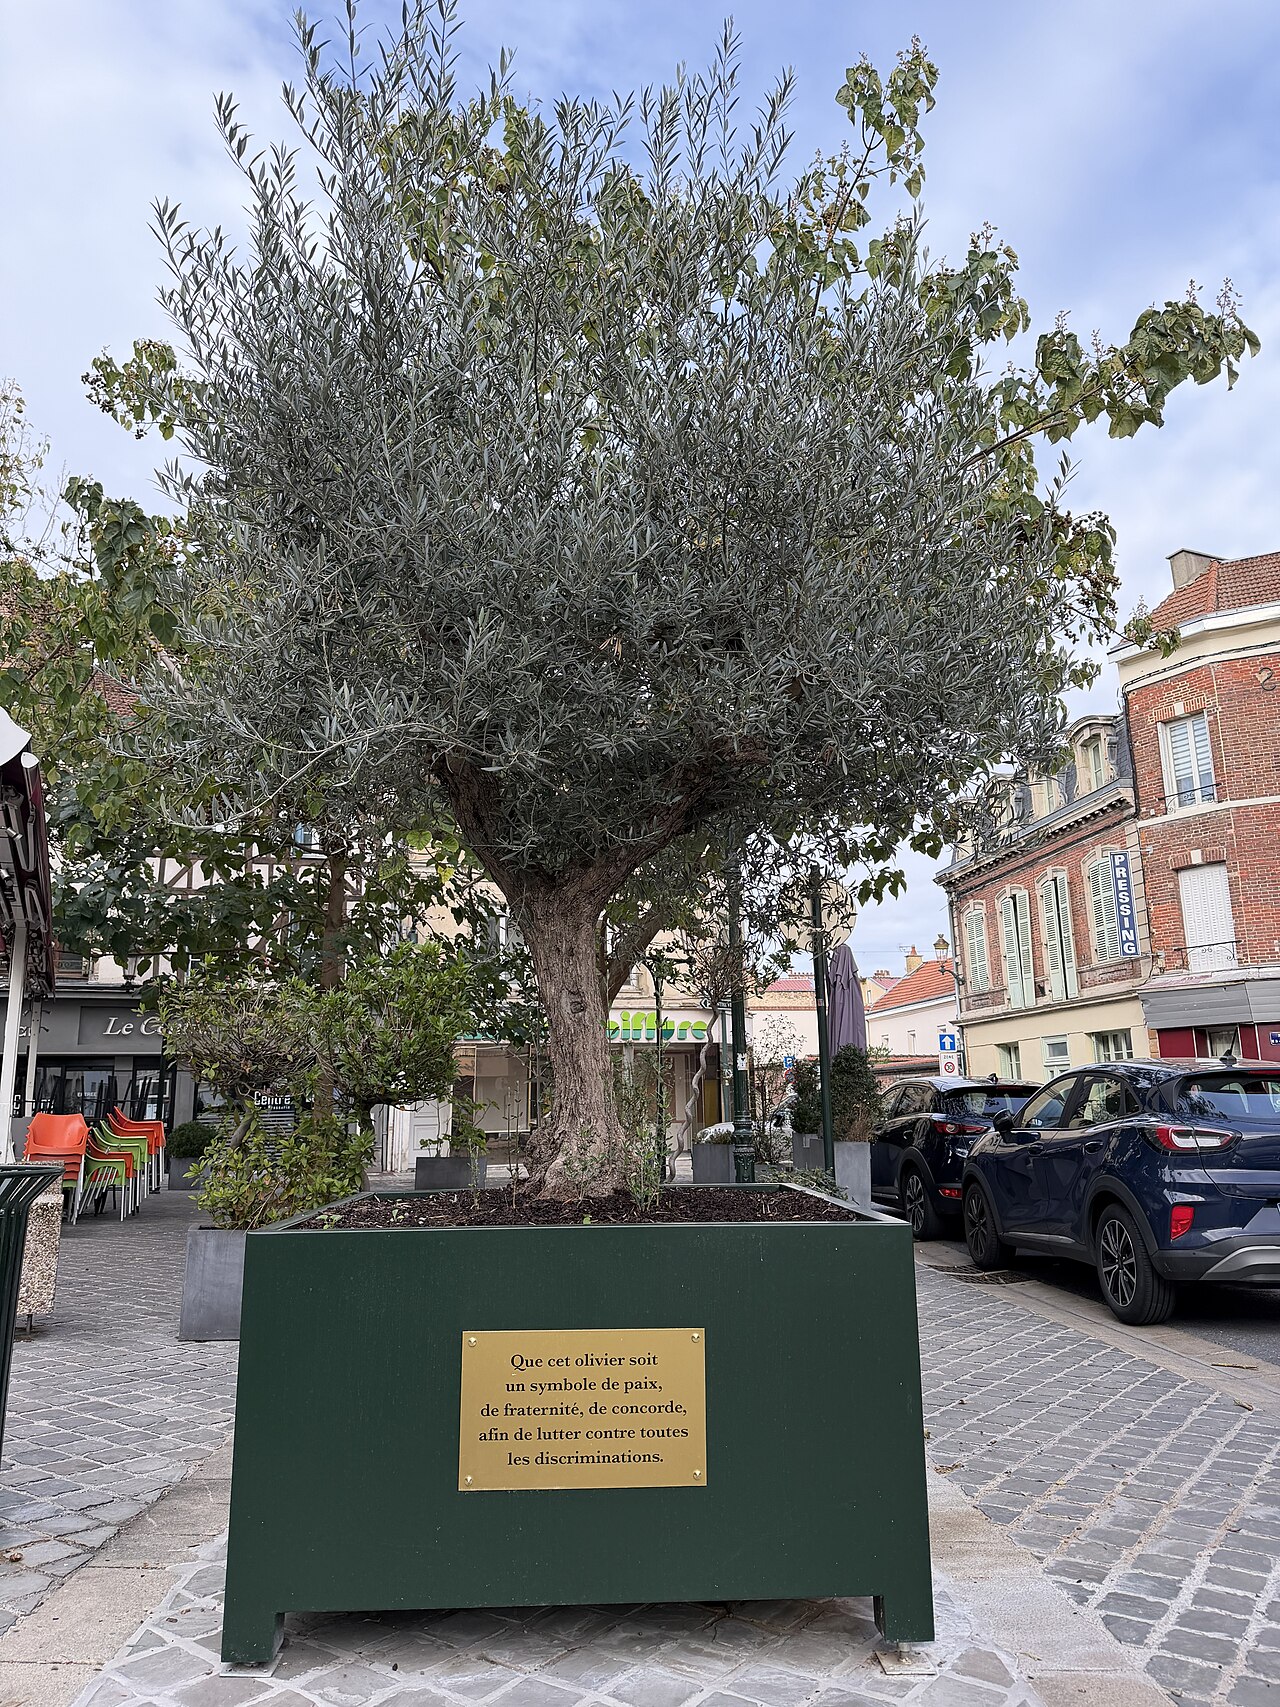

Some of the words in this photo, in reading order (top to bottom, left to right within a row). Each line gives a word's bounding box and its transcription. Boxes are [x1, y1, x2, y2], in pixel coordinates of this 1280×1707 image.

[1113, 854, 1137, 954] PRESSING
[102, 1017, 134, 1035] Le
[605, 1010, 708, 1041] oiffure
[511, 1354, 543, 1371] Que
[547, 1356, 571, 1367] cet
[575, 1353, 626, 1366] olivier
[629, 1353, 659, 1366] soit
[505, 1383, 526, 1392] un
[530, 1378, 597, 1395] symbole
[601, 1377, 620, 1390] de
[624, 1376, 663, 1393] paix,
[480, 1404, 499, 1417] de
[503, 1402, 584, 1418] fraternité,
[588, 1402, 608, 1415] de
[612, 1400, 687, 1416] concorde,
[478, 1427, 509, 1441] afin
[513, 1427, 533, 1441] de
[536, 1427, 582, 1440] lutter
[585, 1427, 636, 1439] contre
[640, 1427, 689, 1439] toutes
[507, 1452, 530, 1466] les
[534, 1450, 664, 1465] discriminations.
